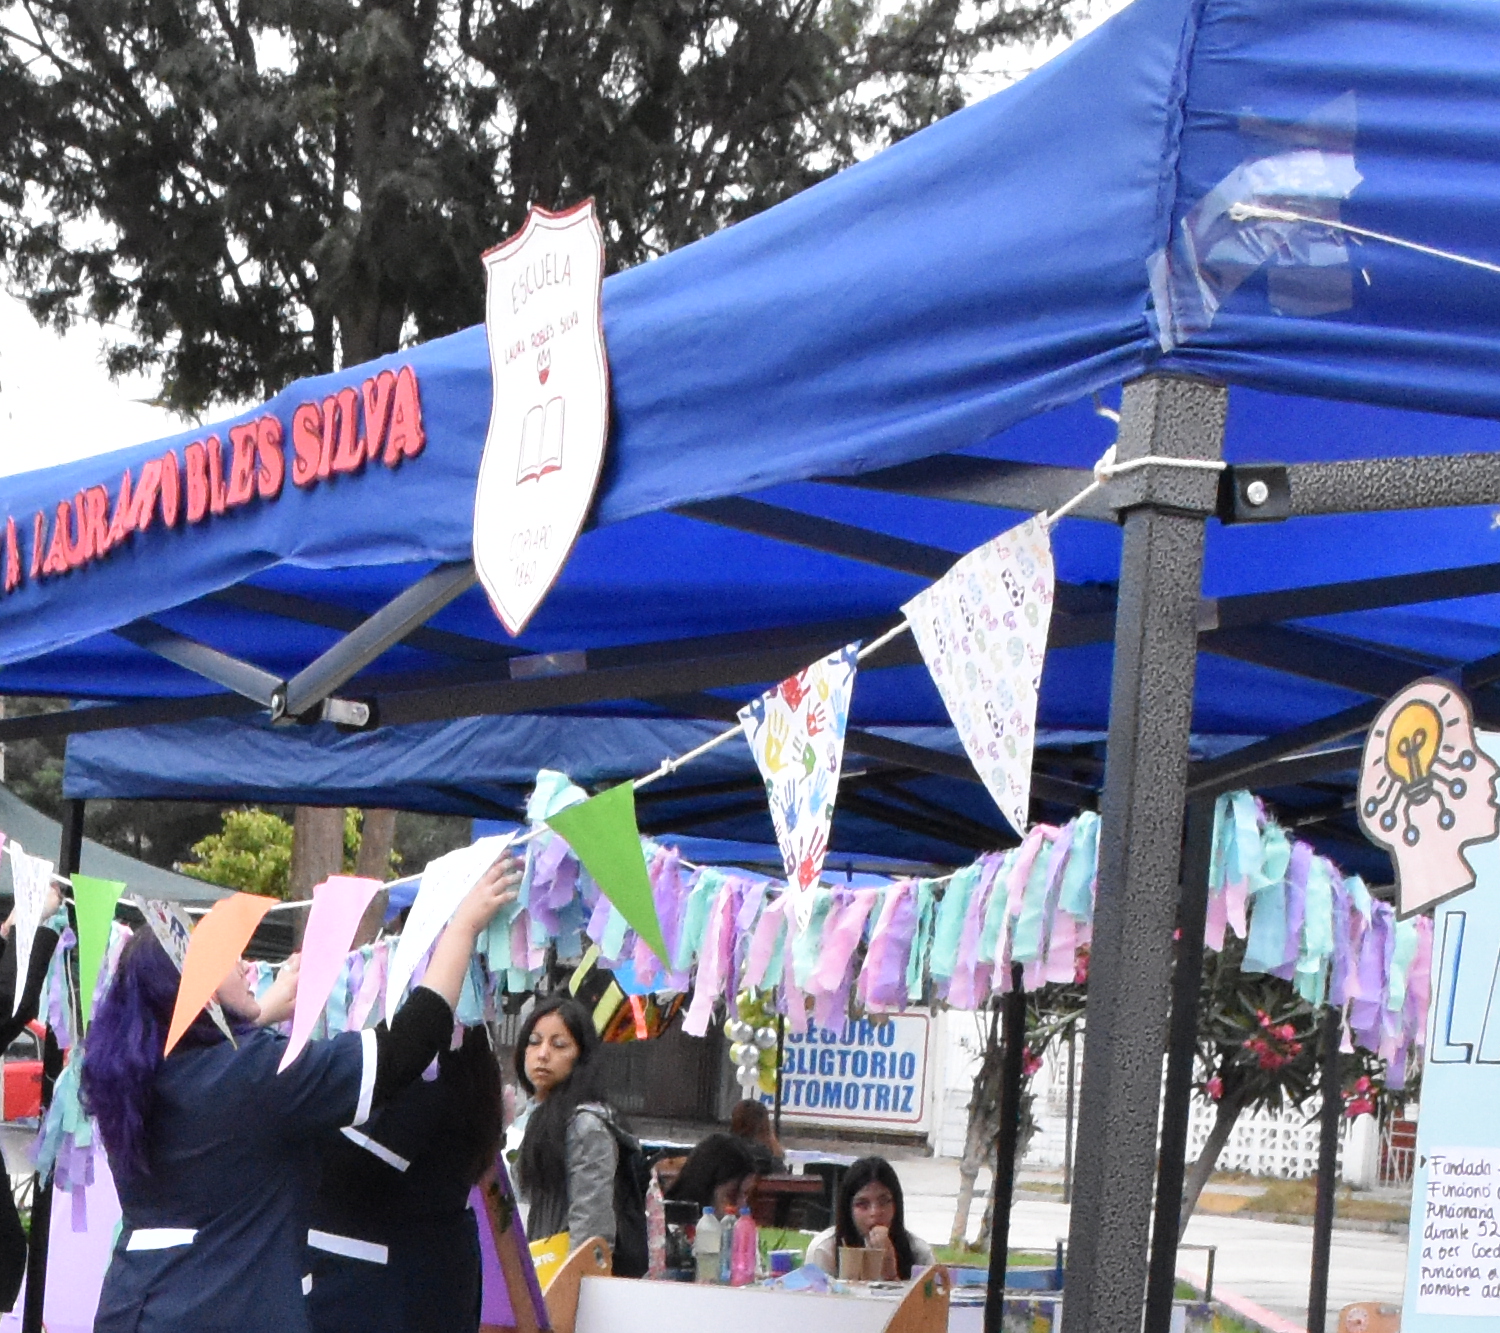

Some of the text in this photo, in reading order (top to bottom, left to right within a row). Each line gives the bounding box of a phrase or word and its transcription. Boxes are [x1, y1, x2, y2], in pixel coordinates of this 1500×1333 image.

[512, 253, 571, 314] ESCUELA
[505, 310, 578, 364] LAURA ROBLES SILVA
[292, 364, 426, 489] SILVA
[782, 1047, 916, 1080] BLIGTORIO
[1424, 1227, 1469, 1240] durante
[1422, 1250, 1432, 1259] a
[1439, 1246, 1460, 1260] ser
[1420, 1283, 1471, 1297] nombre
